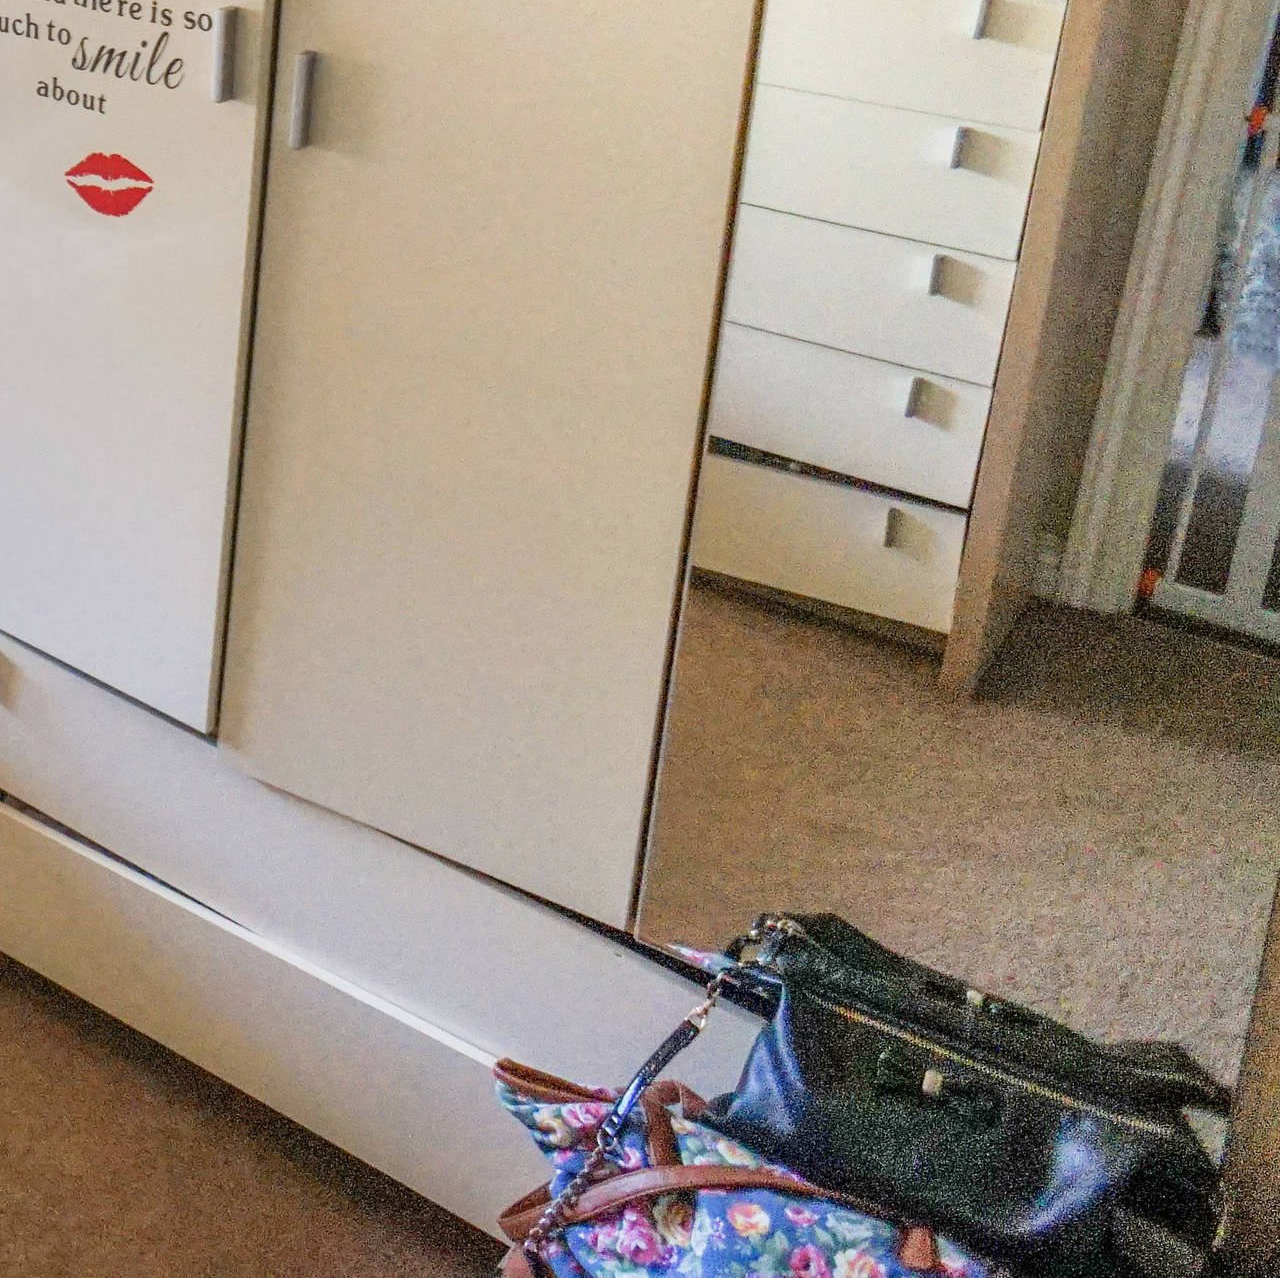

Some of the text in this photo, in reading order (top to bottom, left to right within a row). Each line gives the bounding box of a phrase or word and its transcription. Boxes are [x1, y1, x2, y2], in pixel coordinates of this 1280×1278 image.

[150, 1, 173, 27] is
[183, 10, 213, 32] so
[46, 21, 71, 46] to
[71, 31, 185, 89] smile
[36, 76, 107, 114] about
